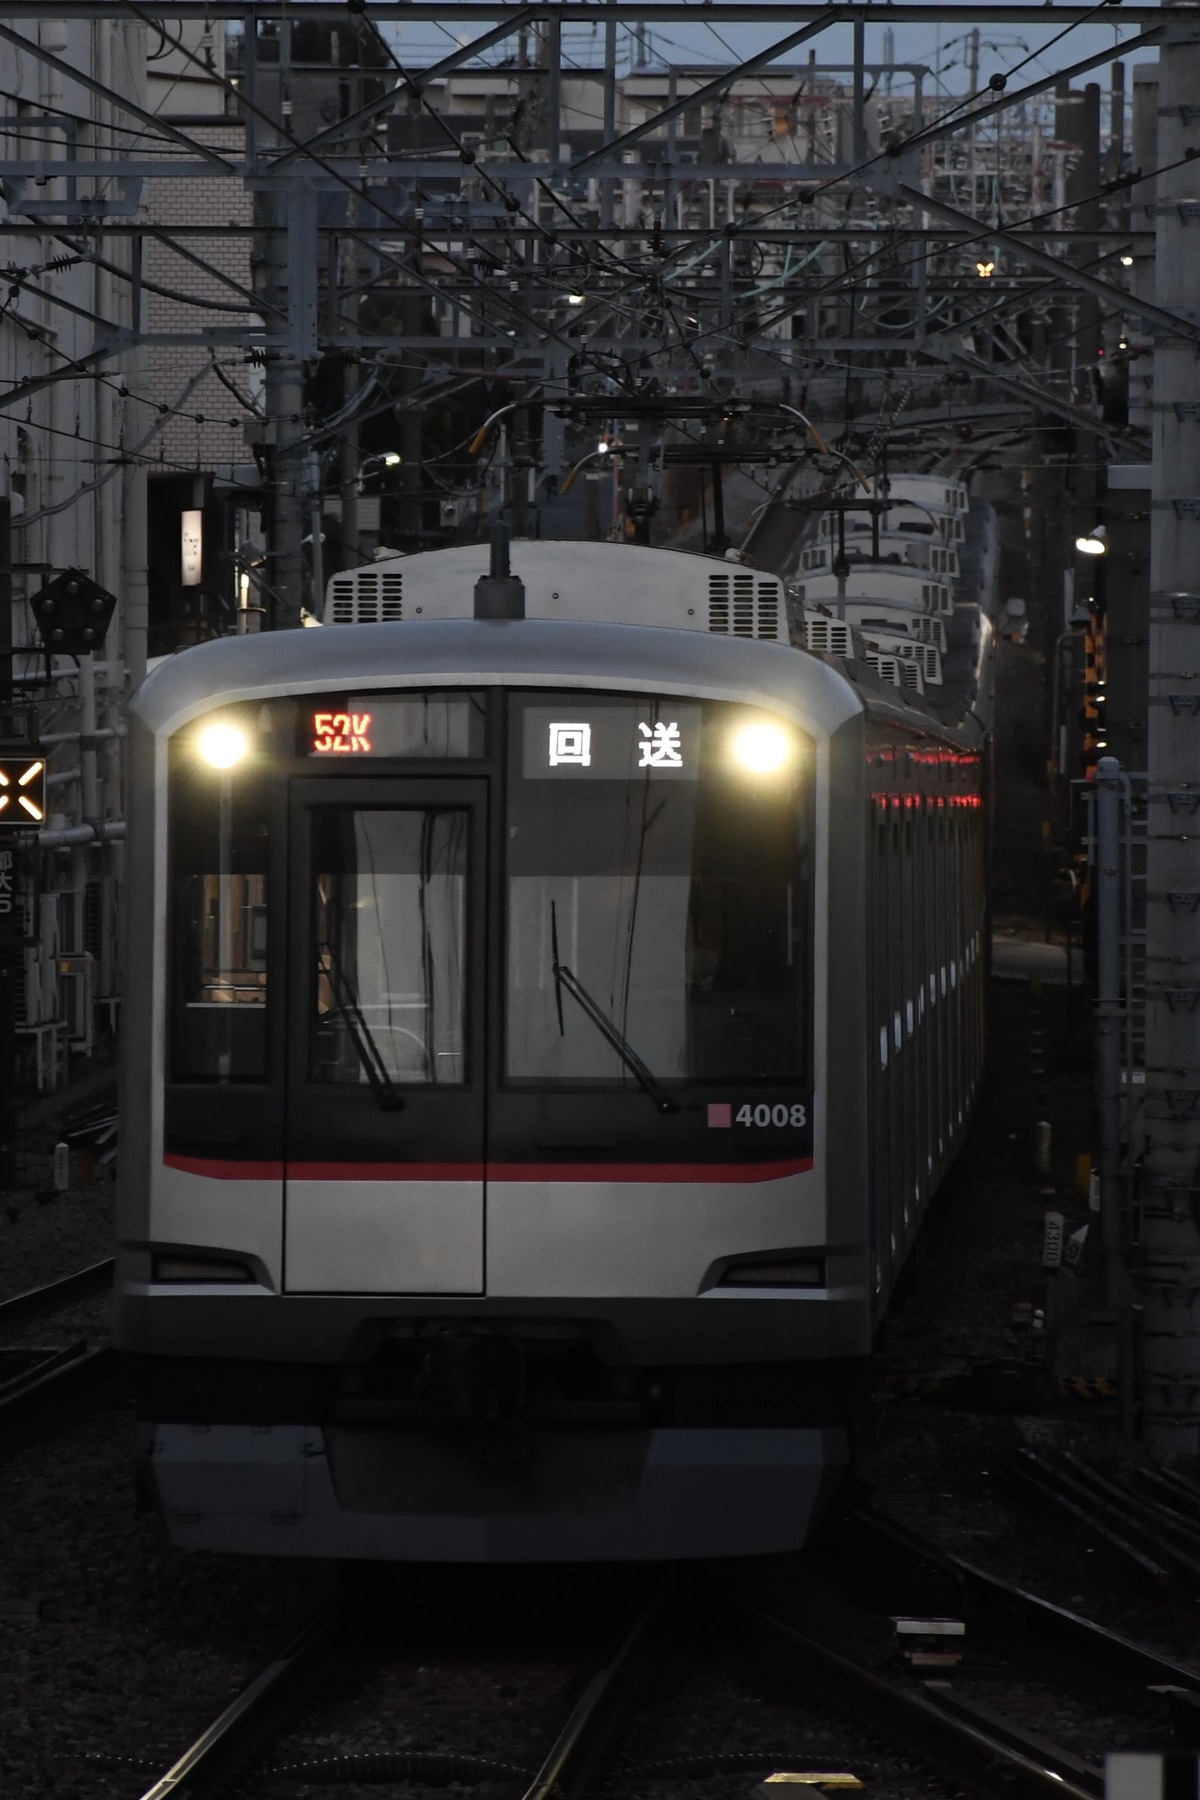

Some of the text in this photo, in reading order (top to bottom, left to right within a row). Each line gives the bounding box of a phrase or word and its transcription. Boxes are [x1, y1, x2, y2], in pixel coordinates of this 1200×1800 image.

[314, 713, 371, 752] 52K
[549, 721, 684, 768] 回送
[735, 1104, 807, 1128] 4008
[1045, 1221, 1061, 1261] 4300
